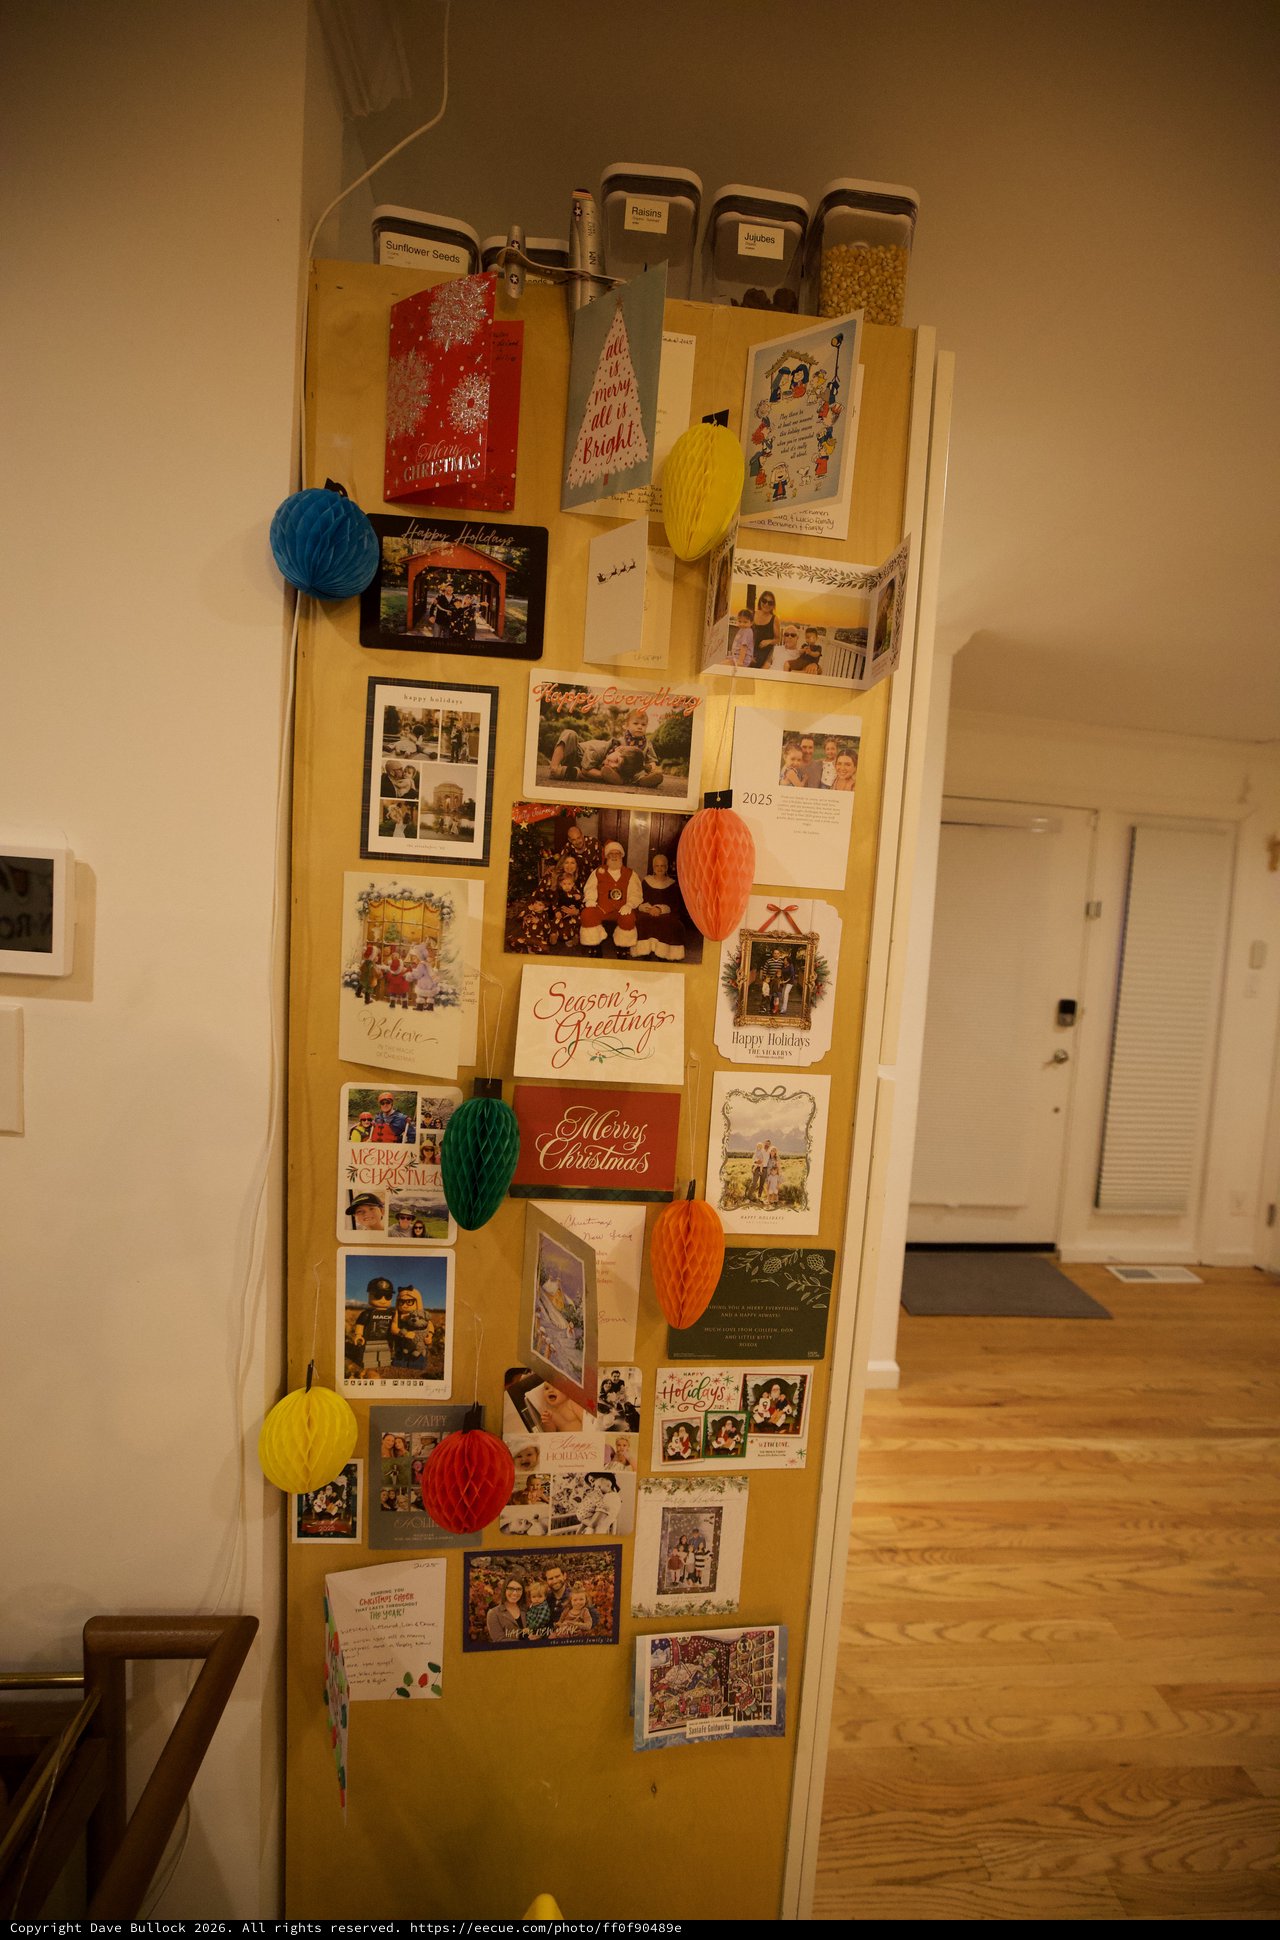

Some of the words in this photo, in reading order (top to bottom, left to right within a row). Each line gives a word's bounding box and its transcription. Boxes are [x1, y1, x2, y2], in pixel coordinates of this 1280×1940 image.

[632, 206, 662, 218] Raisins
[386, 240, 430, 257] Sunflower
[432, 249, 461, 264] Seeds
[744, 232, 776, 246] Jujubes
[606, 335, 624, 361] all
[609, 360, 620, 378] is
[594, 377, 632, 406] merry
[591, 404, 613, 432] all
[616, 401, 628, 421] is
[416, 440, 464, 464] Merry
[583, 420, 634, 465] Bright
[403, 452, 481, 483] CHRISTMAS
[401, 518, 450, 548] Happy
[454, 523, 515, 548] Holidays
[403, 694, 427, 703] happy
[430, 696, 464, 705] holidays
[532, 682, 600, 713] Happy
[602, 686, 703, 717] Everything
[742, 792, 773, 806] 2025
[533, 981, 648, 1020] Season's
[358, 1010, 438, 1044] Believe
[552, 1009, 675, 1069] Greetings
[732, 1031, 763, 1048] Happy
[768, 1033, 810, 1050] Holidays
[555, 1106, 648, 1151] Merry
[351, 1148, 409, 1169] MERRY
[535, 1133, 651, 1174] Christmas
[657, 1376, 726, 1412] Holidays
[405, 1415, 447, 1427] HAPPY
[546, 1450, 598, 1462] HOLIDAYS
